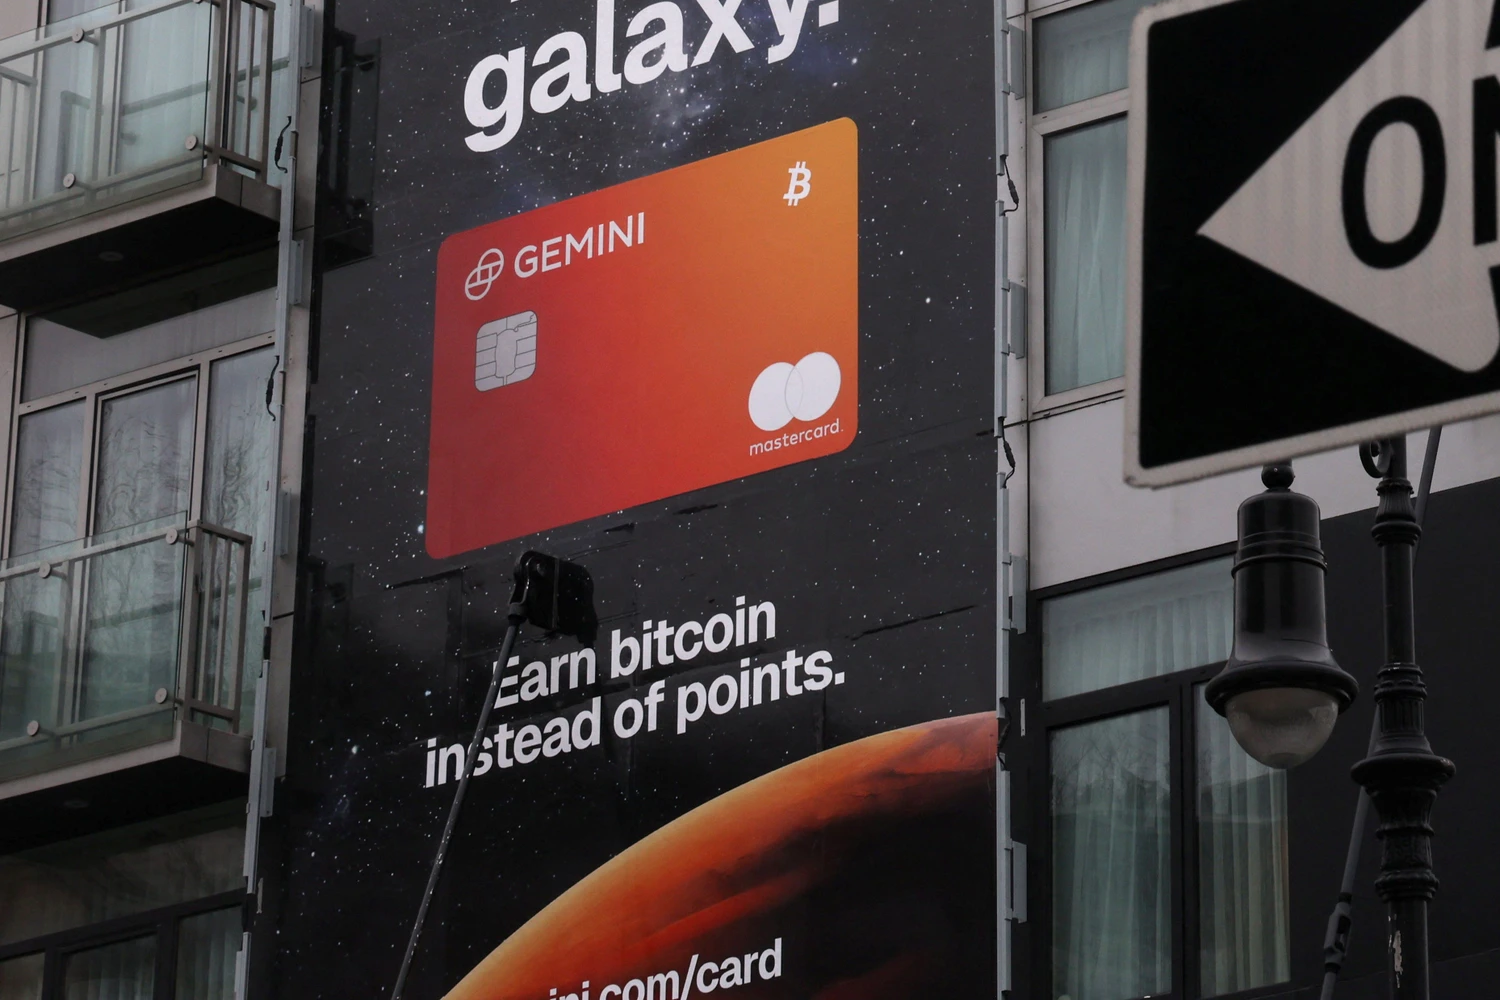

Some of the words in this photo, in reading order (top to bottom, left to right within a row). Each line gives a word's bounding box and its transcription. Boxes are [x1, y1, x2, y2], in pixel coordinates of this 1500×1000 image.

[514, 212, 645, 278] GEMINI
[610, 595, 776, 678] bitcoin
[425, 695, 602, 788] instead
[614, 680, 666, 739] of
[676, 650, 845, 735] points.
